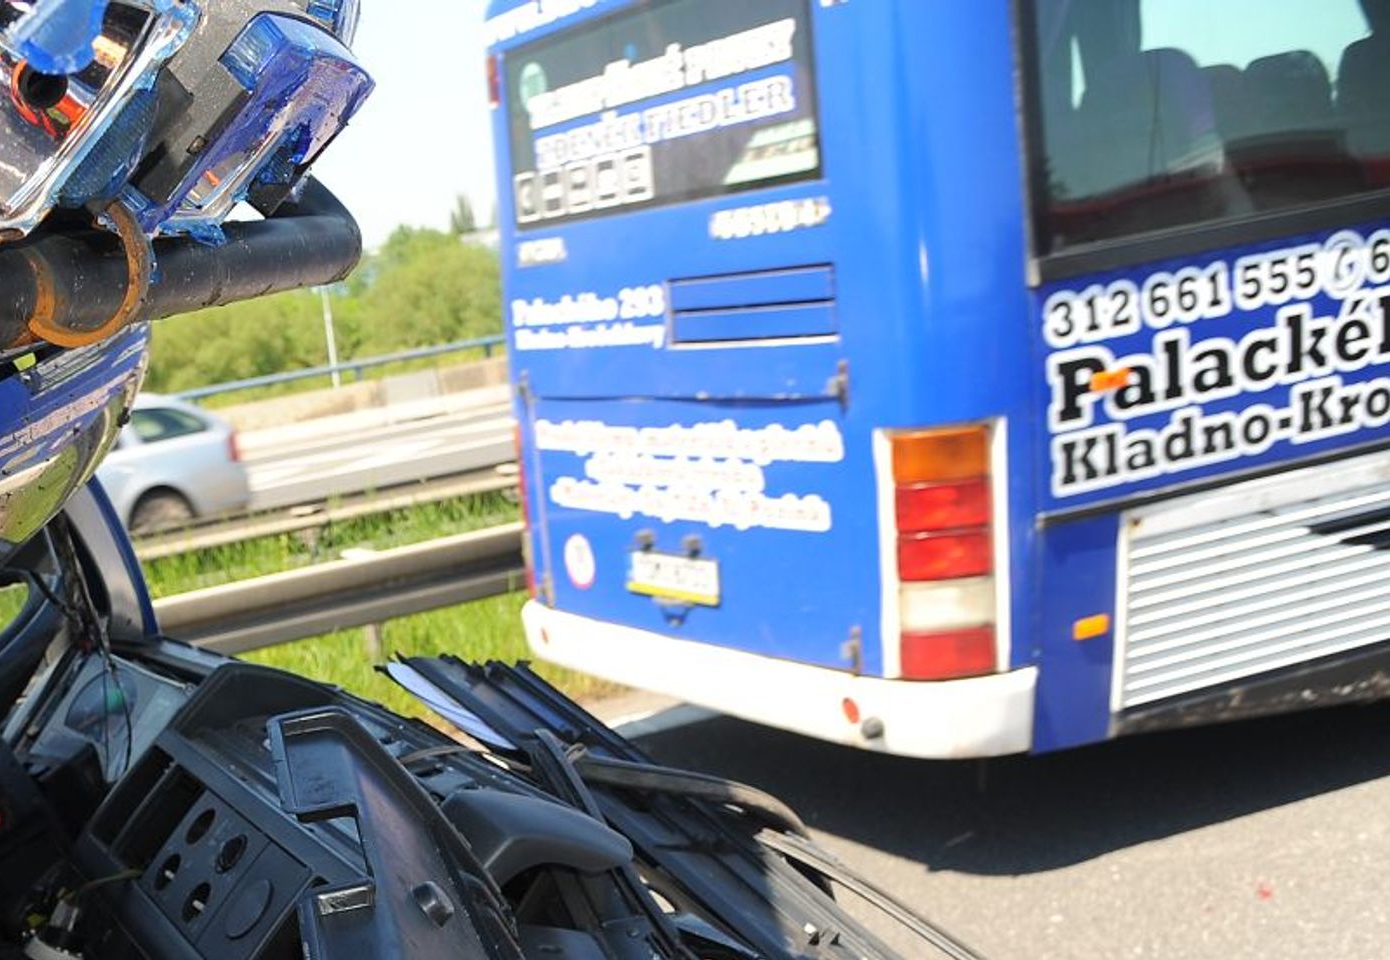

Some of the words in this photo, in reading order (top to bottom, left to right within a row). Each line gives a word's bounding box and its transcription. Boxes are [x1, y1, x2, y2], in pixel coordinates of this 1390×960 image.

[646, 78, 793, 141] FIEDLER
[1050, 289, 1132, 339] 312
[1147, 269, 1222, 319] 661
[1241, 251, 1316, 300] 555
